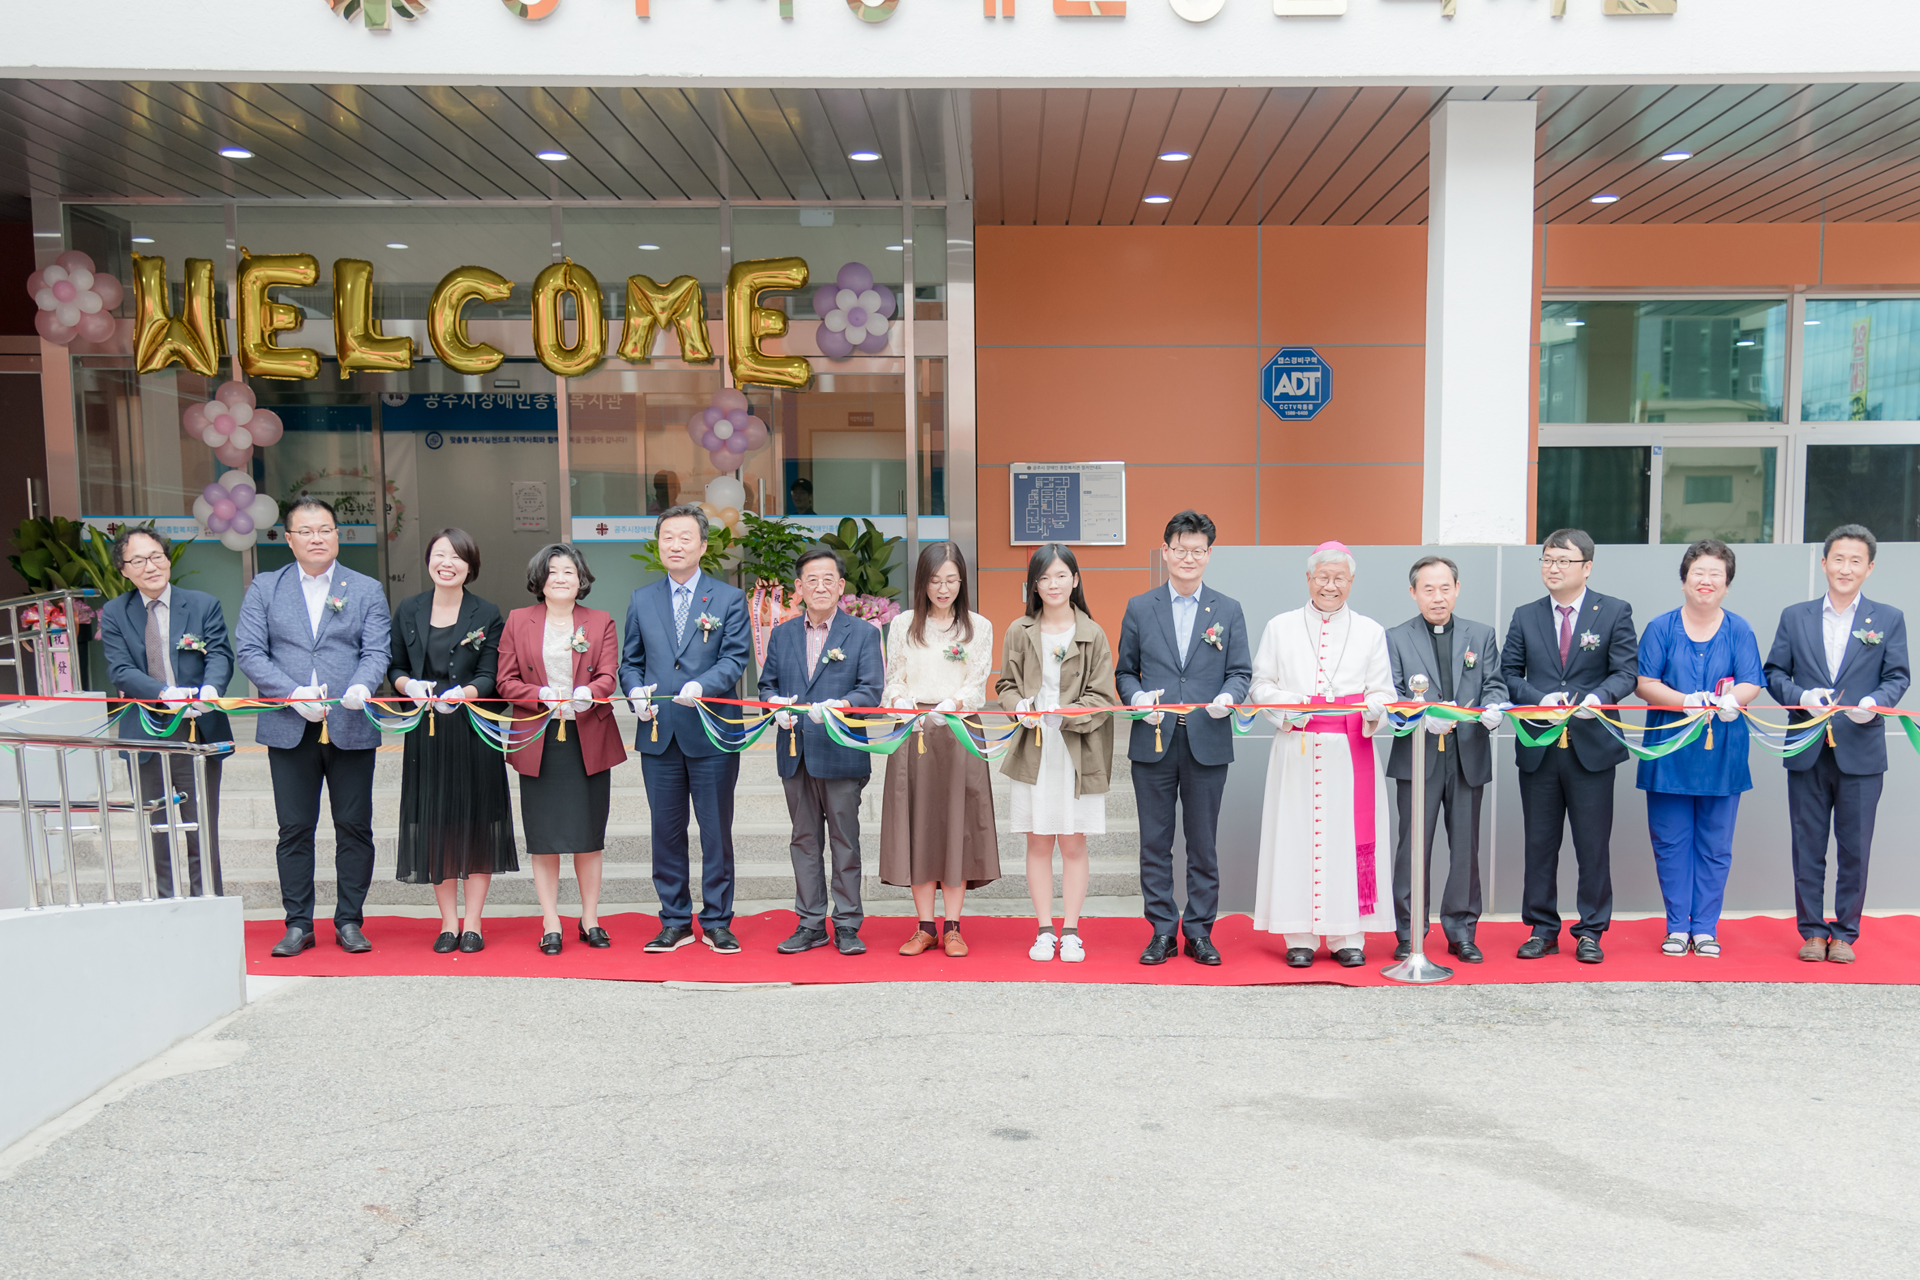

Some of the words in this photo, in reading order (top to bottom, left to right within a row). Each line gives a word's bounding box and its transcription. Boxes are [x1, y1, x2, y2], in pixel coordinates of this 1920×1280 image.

[132, 248, 811, 388] WELCOME
[1274, 371, 1320, 396] ADT
[512, 436, 546, 444] 지역사회와
